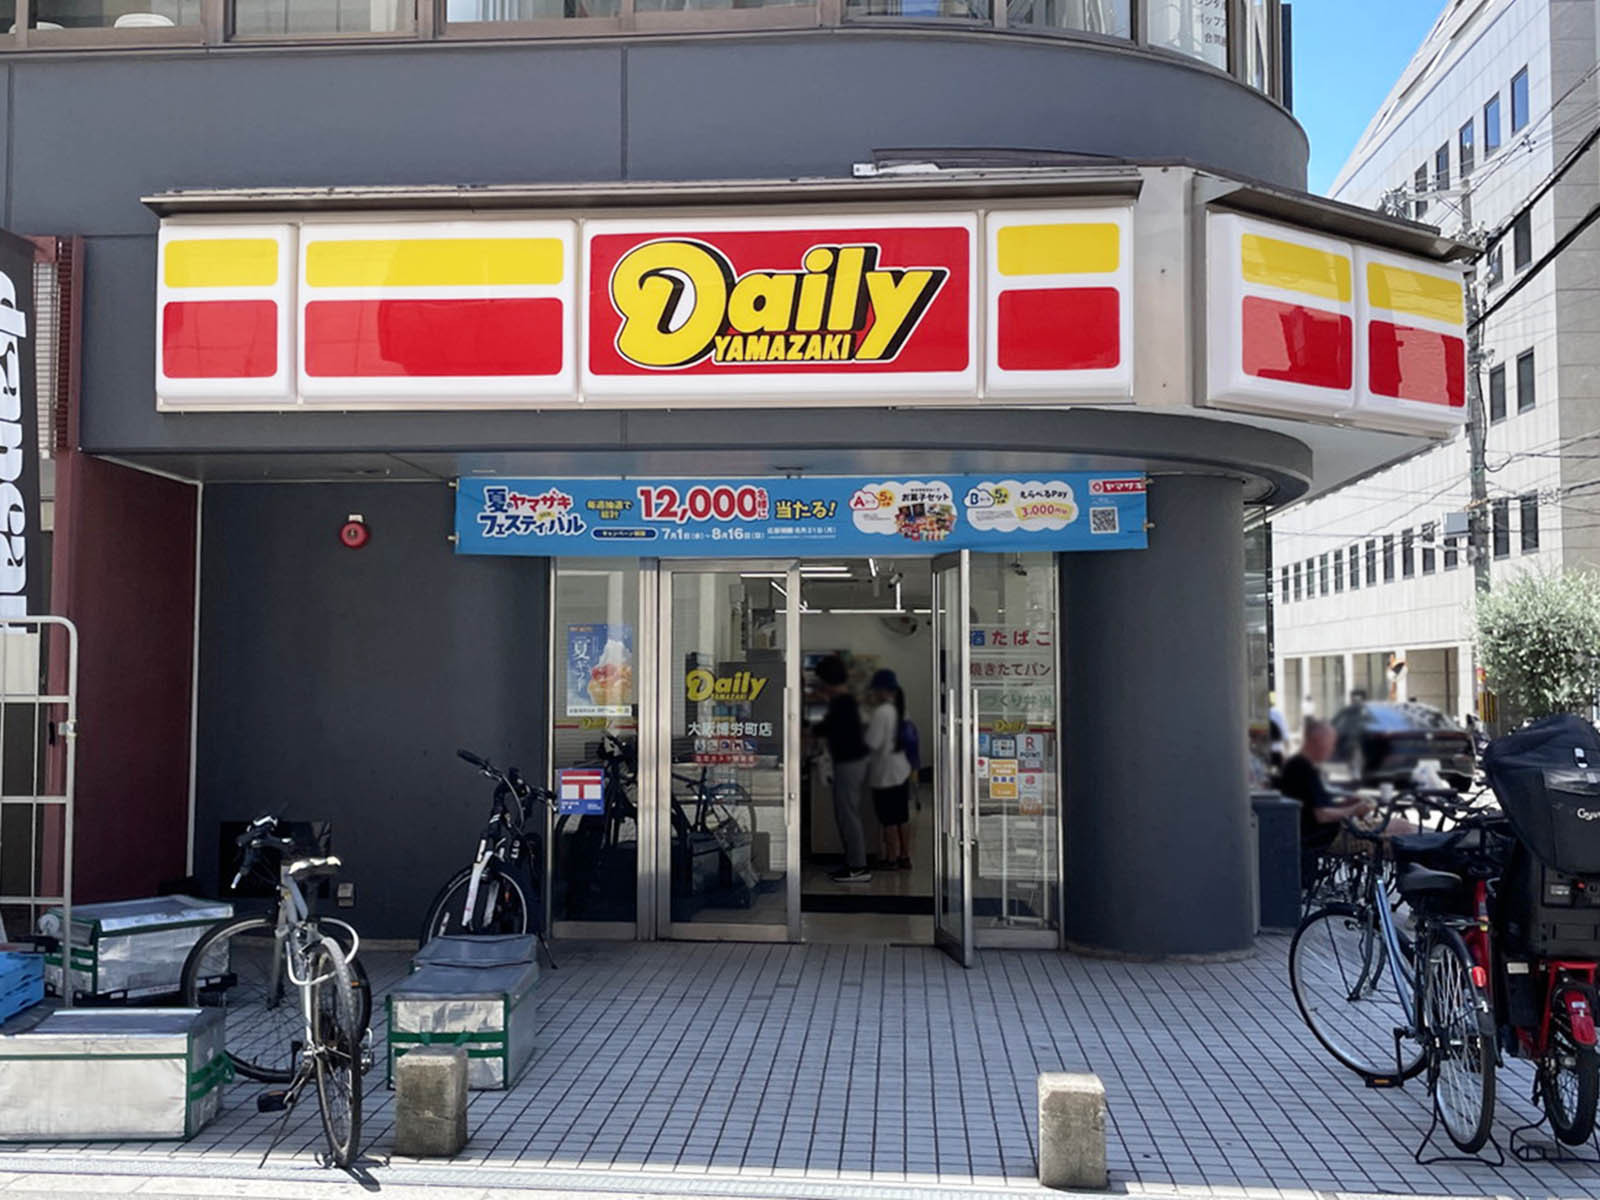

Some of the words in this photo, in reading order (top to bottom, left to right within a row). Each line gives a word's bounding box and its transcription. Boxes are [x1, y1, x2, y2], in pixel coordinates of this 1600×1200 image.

[609, 238, 950, 368] Daily
[714, 334, 851, 361] YAMAZAKI
[479, 511, 584, 536] フェスティバル
[991, 629, 1052, 647] たばこ
[686, 669, 767, 701] Daily
